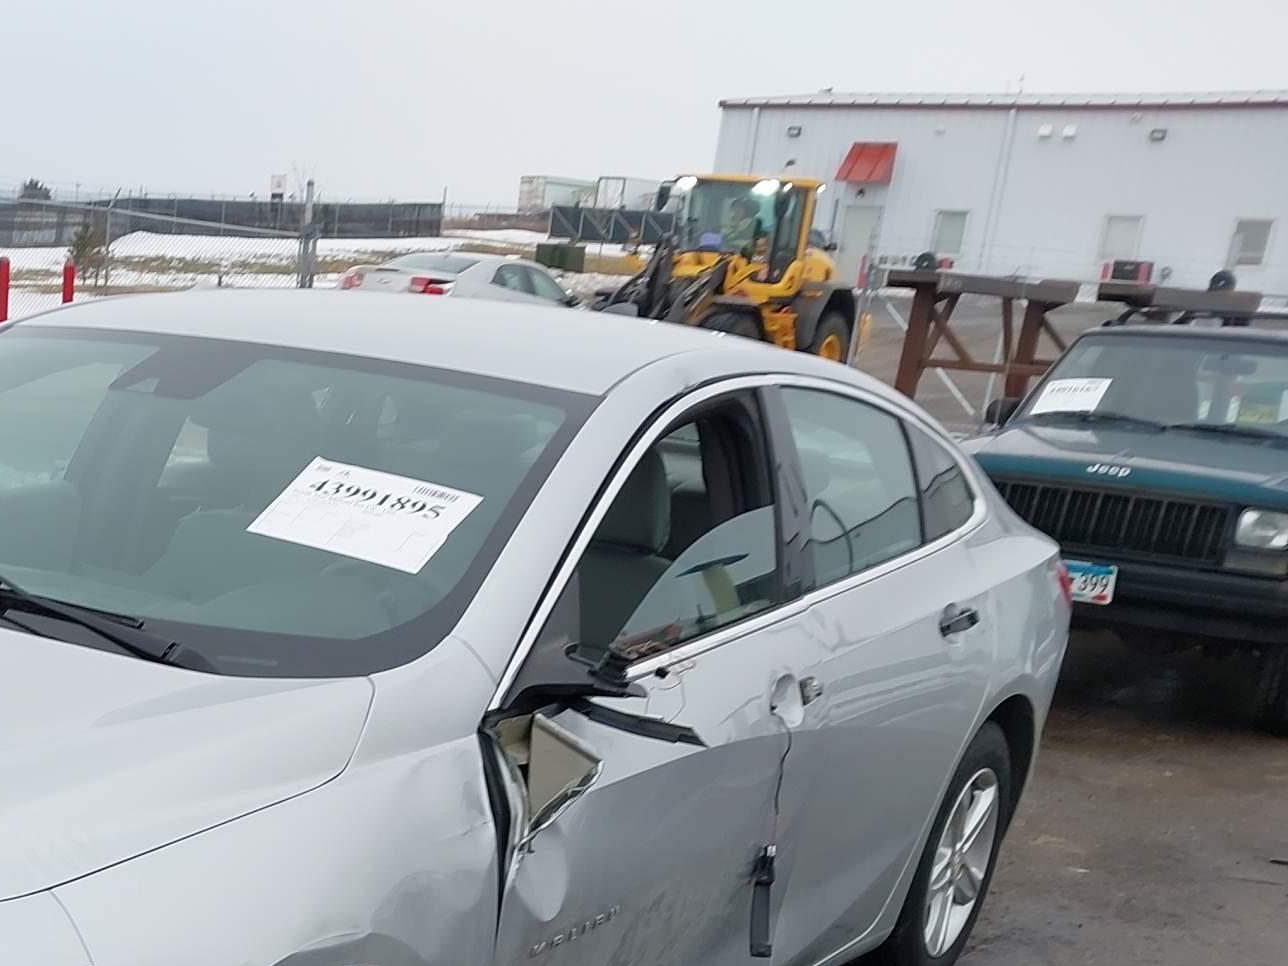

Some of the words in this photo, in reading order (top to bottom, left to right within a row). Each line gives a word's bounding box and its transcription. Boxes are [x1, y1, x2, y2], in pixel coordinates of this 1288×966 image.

[1086, 463, 1132, 477] Jeep
[309, 479, 447, 520] 43991895
[1079, 573, 1109, 593] 399
